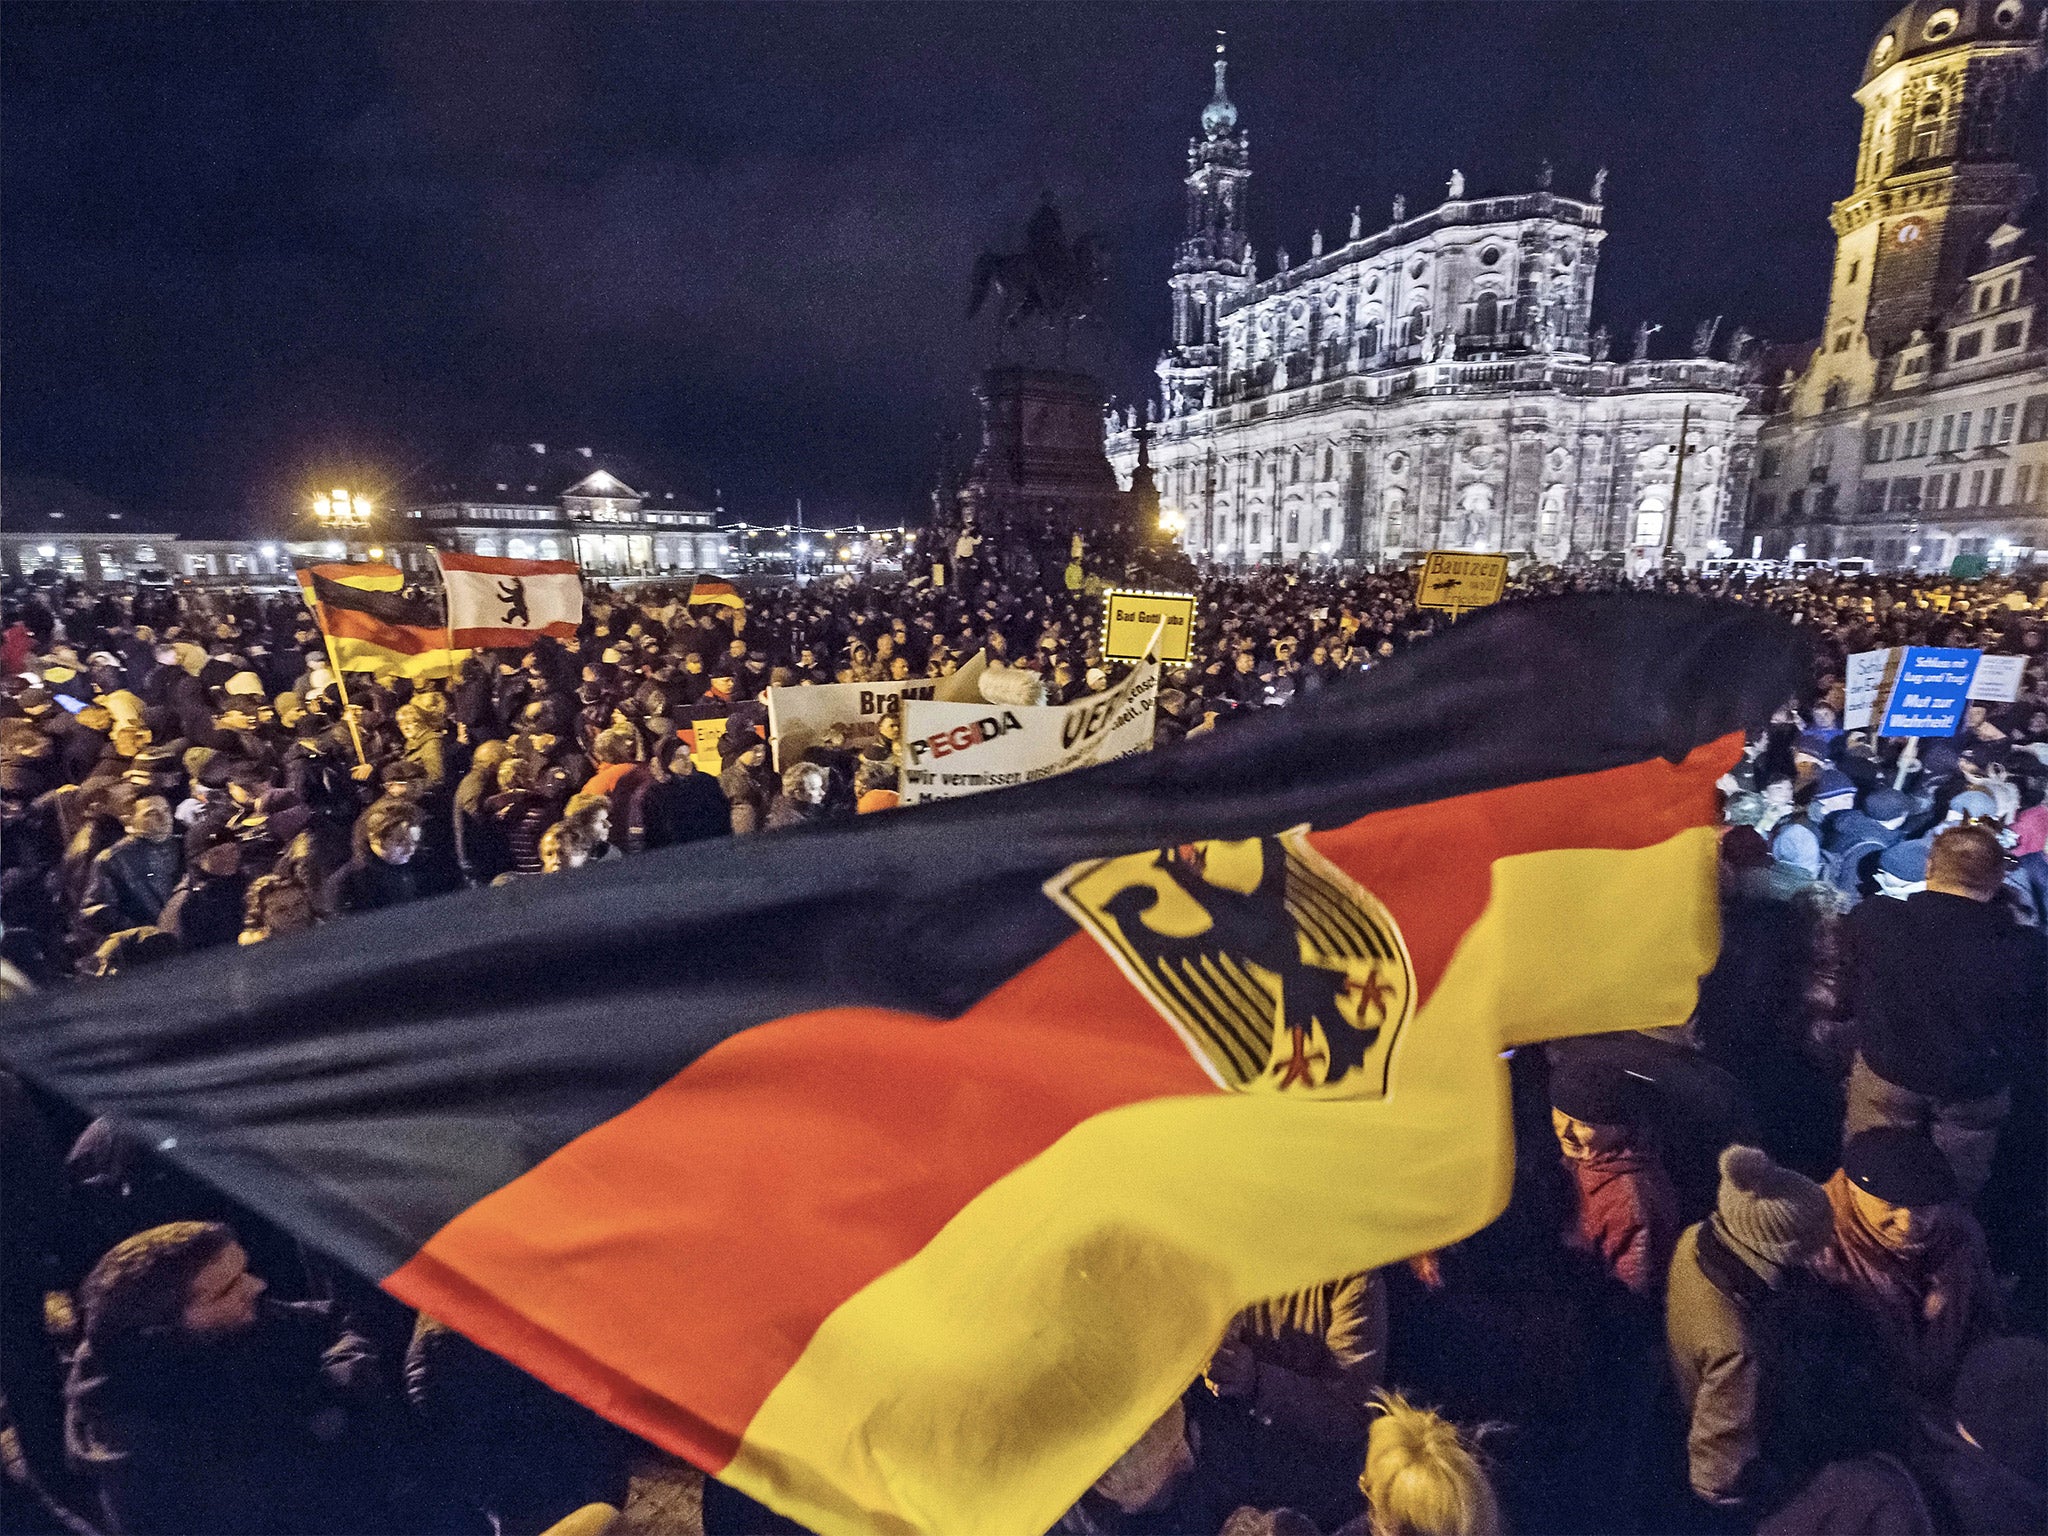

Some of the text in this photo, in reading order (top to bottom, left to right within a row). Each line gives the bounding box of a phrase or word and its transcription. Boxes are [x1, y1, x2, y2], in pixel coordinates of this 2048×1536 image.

[1431, 556, 1499, 577] Bautzen
[1116, 609, 1185, 626] Bad Gottluba
[1902, 694, 1931, 707] Mut
[907, 711, 1023, 765] PEGIDA
[906, 769, 936, 785] Wir
